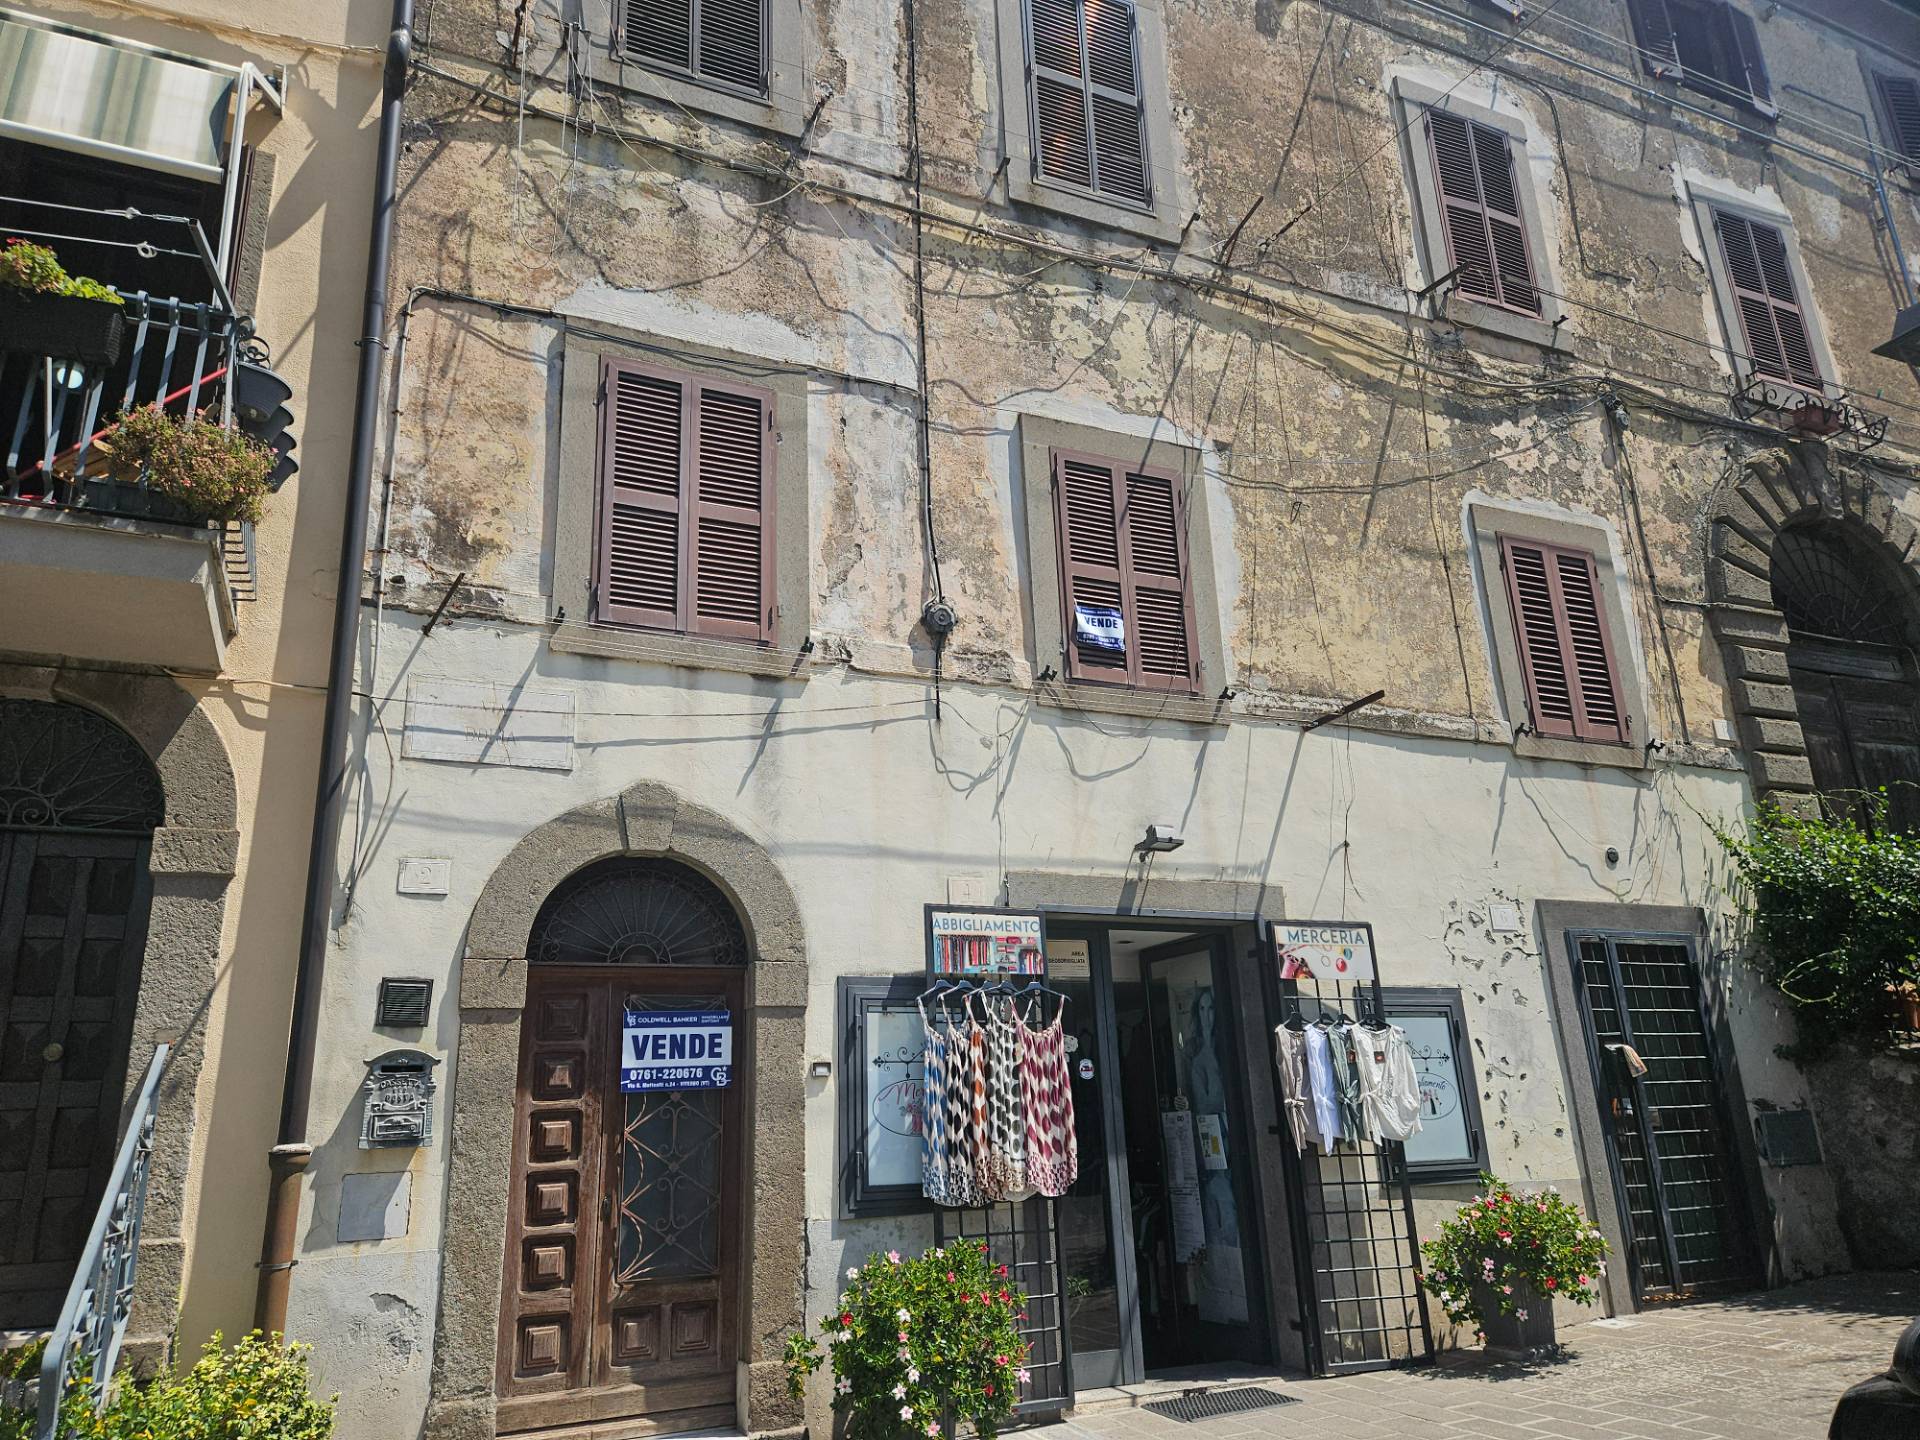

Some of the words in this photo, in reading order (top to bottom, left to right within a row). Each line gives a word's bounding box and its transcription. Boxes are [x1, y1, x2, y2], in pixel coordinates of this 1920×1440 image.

[1084, 616, 1118, 629] VENDE
[932, 918, 1040, 933] ABBIGLIAMENTO
[1287, 928, 1365, 944] MERCERIA
[631, 1033, 723, 1061] VENDE
